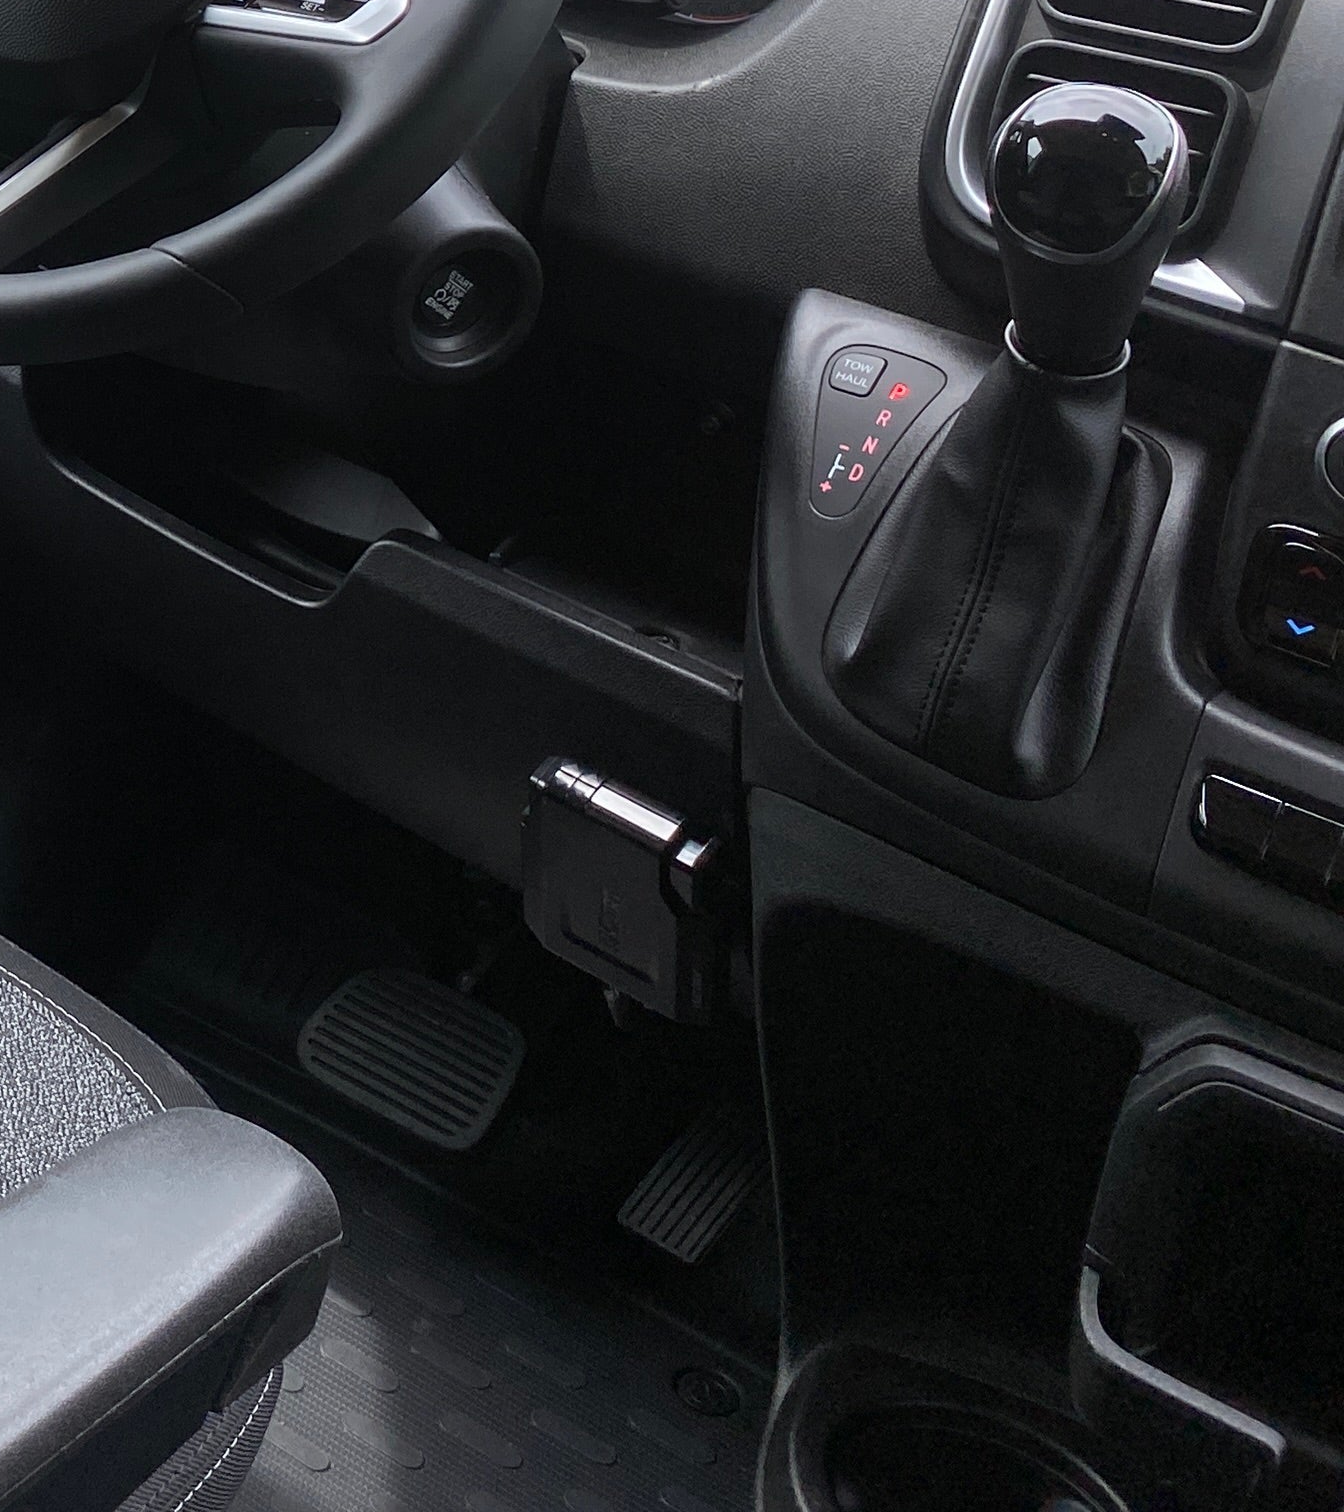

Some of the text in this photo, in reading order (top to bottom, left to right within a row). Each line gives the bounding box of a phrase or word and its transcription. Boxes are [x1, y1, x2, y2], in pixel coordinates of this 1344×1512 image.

[444, 281, 465, 298] STOP
[449, 270, 474, 291] START
[424, 296, 454, 320] ENGINE
[844, 358, 875, 374] TOW
[835, 371, 869, 388] HAUL
[888, 382, 910, 401] P
[876, 410, 892, 427] R
[862, 436, 879, 454] N
[848, 463, 864, 481] D
